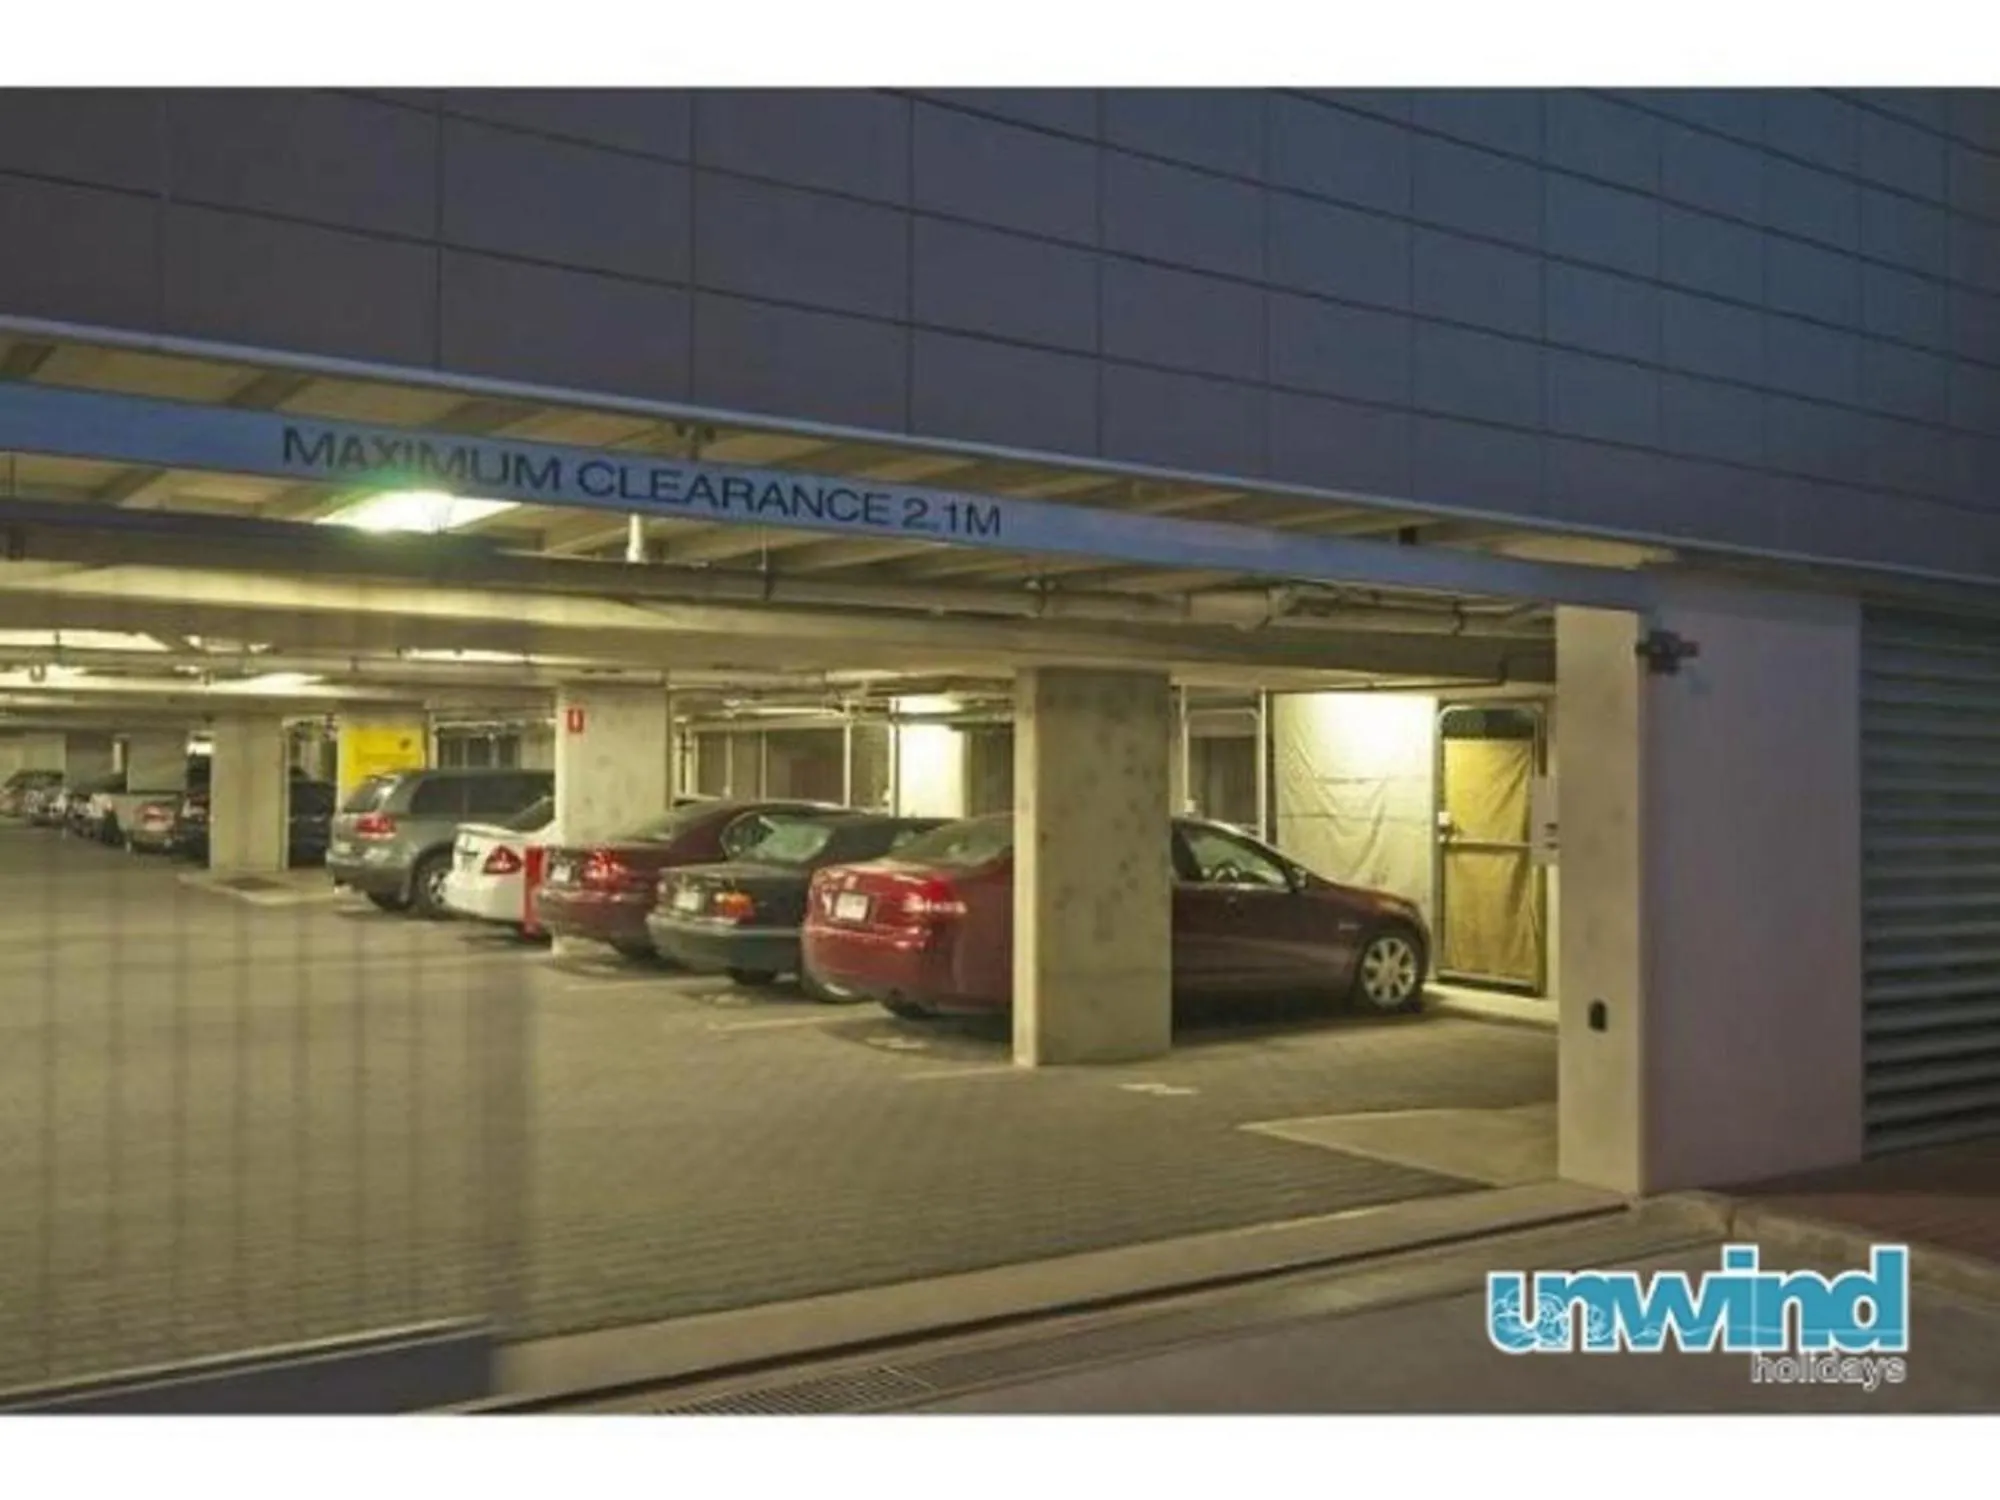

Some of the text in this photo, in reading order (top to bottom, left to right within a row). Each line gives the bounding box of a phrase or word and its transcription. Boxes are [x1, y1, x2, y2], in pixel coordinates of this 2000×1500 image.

[282, 427, 1001, 536] MAXIMUM CLEARANCE 2.1M
